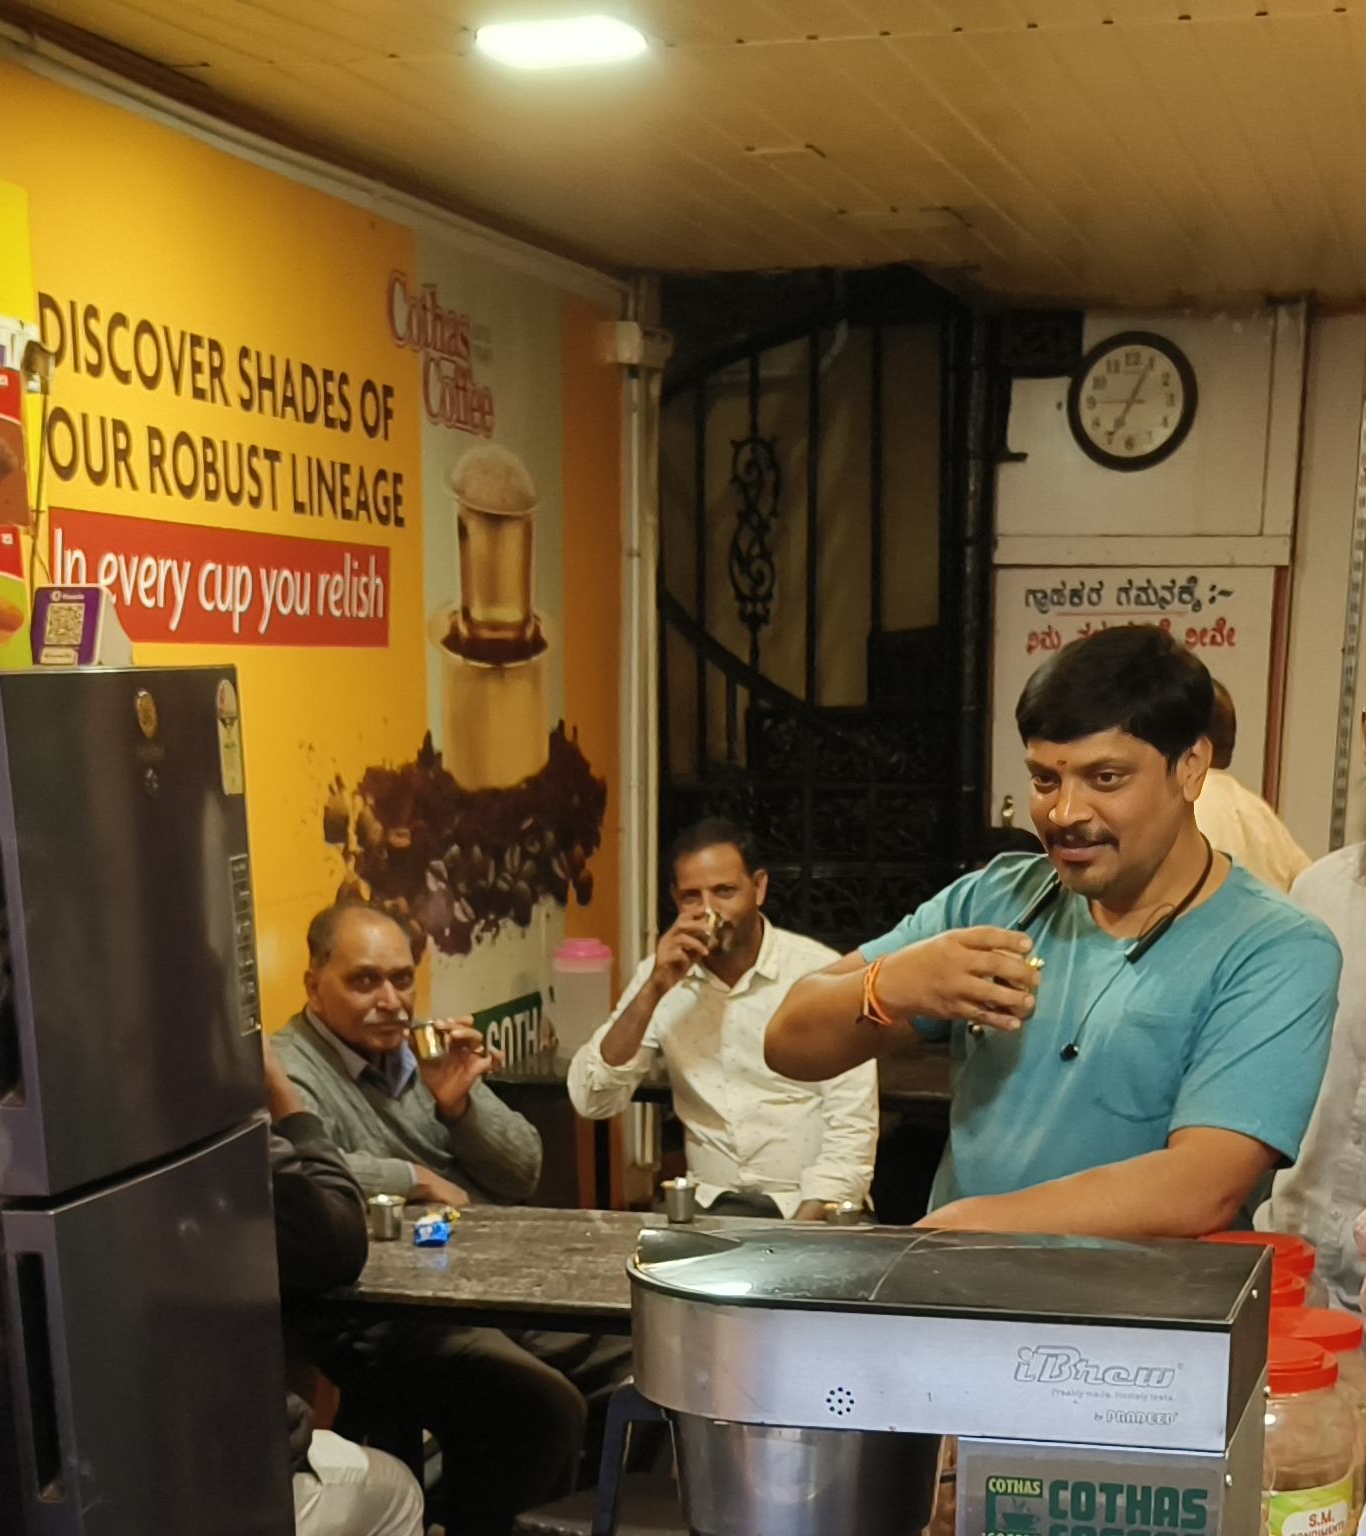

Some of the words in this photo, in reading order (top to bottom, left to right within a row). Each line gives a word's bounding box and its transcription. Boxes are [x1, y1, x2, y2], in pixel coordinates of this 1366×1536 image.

[38, 291, 231, 407] DISCOVER
[238, 345, 352, 433] SHADES
[360, 379, 394, 441] OF
[47, 406, 138, 491] OUR
[147, 425, 282, 511] ROBUST
[290, 453, 406, 528] LINEAGE
[53, 527, 87, 585] In
[97, 551, 191, 631] every
[198, 560, 253, 634] cup
[258, 567, 311, 634] you
[317, 552, 384, 618] relish
[1013, 1345, 1176, 1389] iBrew
[988, 1478, 1041, 1495] COTHAS
[1048, 1480, 1209, 1530] COTHAS
[1308, 1509, 1335, 1528] S.M.
